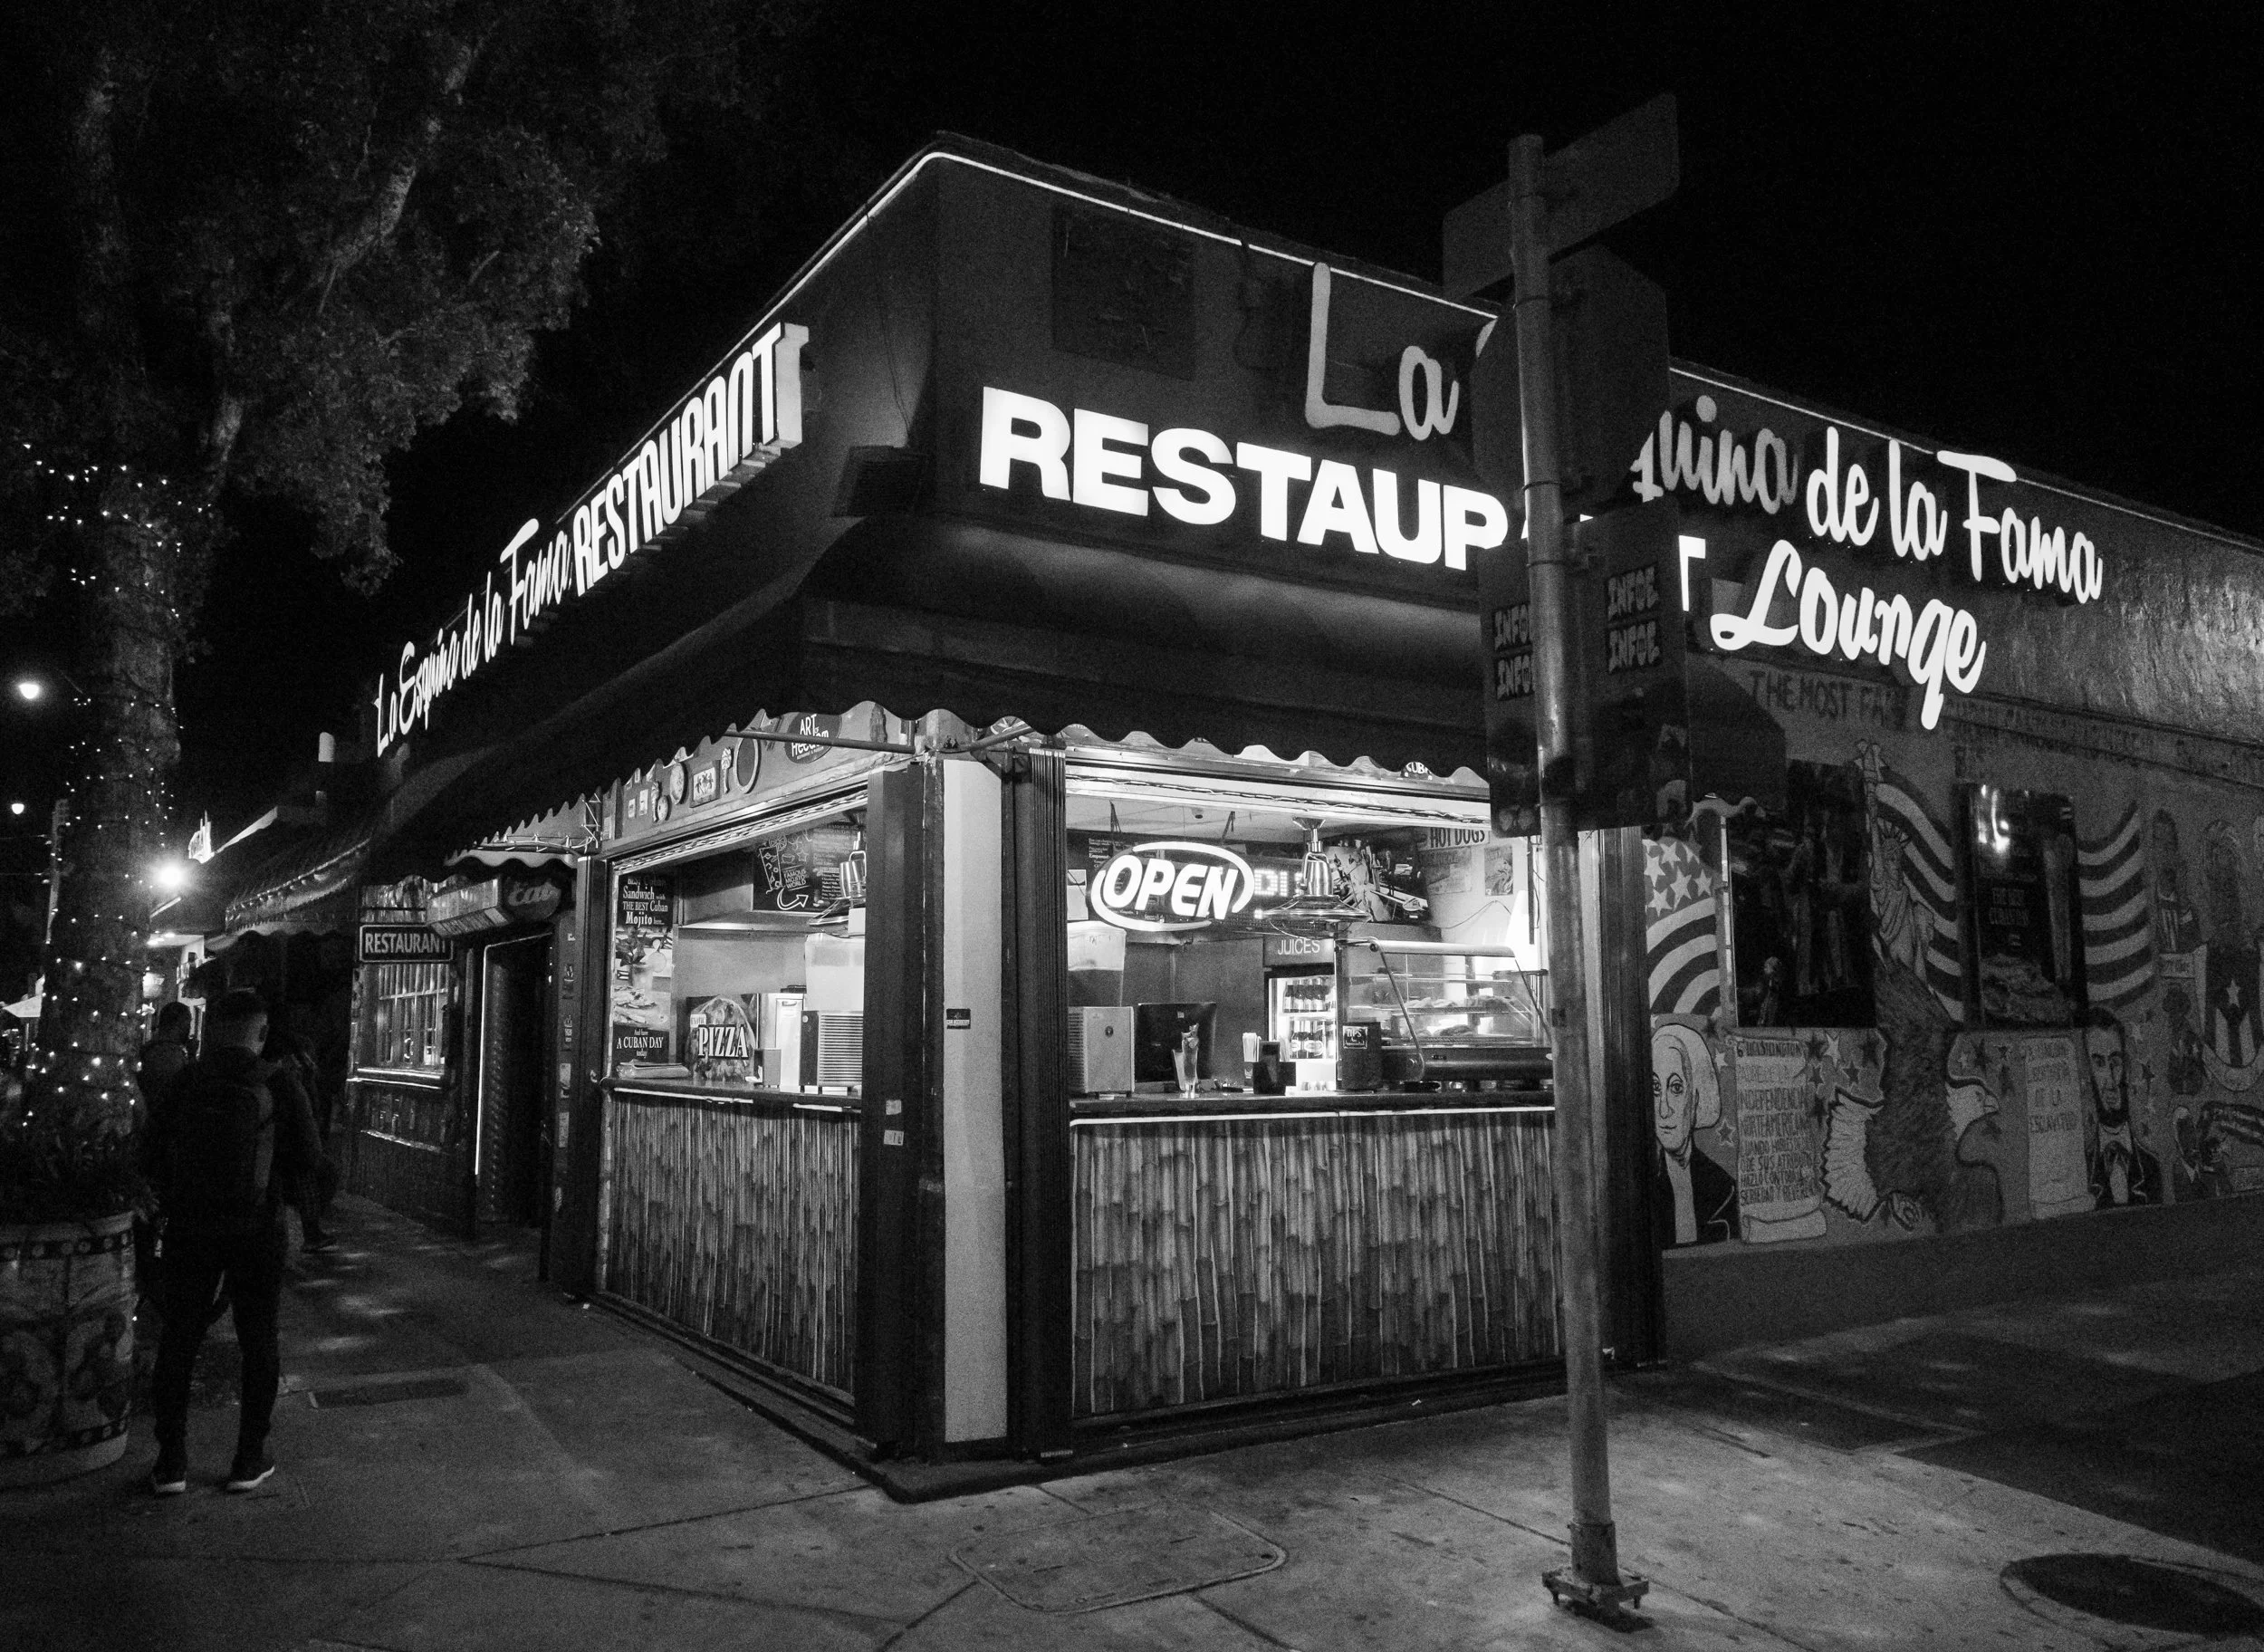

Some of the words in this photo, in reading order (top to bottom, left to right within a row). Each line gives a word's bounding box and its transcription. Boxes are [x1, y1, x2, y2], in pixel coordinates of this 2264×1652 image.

[1304, 261, 1461, 441] La
[1807, 426, 1879, 547] de
[1888, 438, 1948, 562] la
[1937, 450, 2104, 604] Fama
[374, 673, 398, 758] La
[398, 628, 459, 735] Esquina
[460, 596, 482, 680] de
[484, 571, 504, 663] la
[499, 518, 572, 646] Fama
[572, 322, 788, 597] RESTAURANT
[1710, 539, 1987, 730] Lounge
[1749, 670, 1795, 712] THE
[800, 714, 817, 736] ART
[1430, 828, 1451, 848] HOT
[1454, 829, 1485, 846] DOGS
[623, 885, 655, 899] Sandwich
[786, 879, 807, 889] WORLD
[1102, 854, 1239, 920] OPEN
[1254, 869, 1304, 898] DI
[623, 901, 634, 910] THE
[635, 902, 649, 911] BEST
[649, 900, 668, 912] Cuban
[626, 911, 653, 928] Mojito
[1277, 939, 1320, 956] JUICES
[617, 1037, 622, 1049] A
[623, 1036, 648, 1048] CUBAN
[649, 1036, 664, 1048] DAY
[698, 1026, 749, 1057] PIZZA
